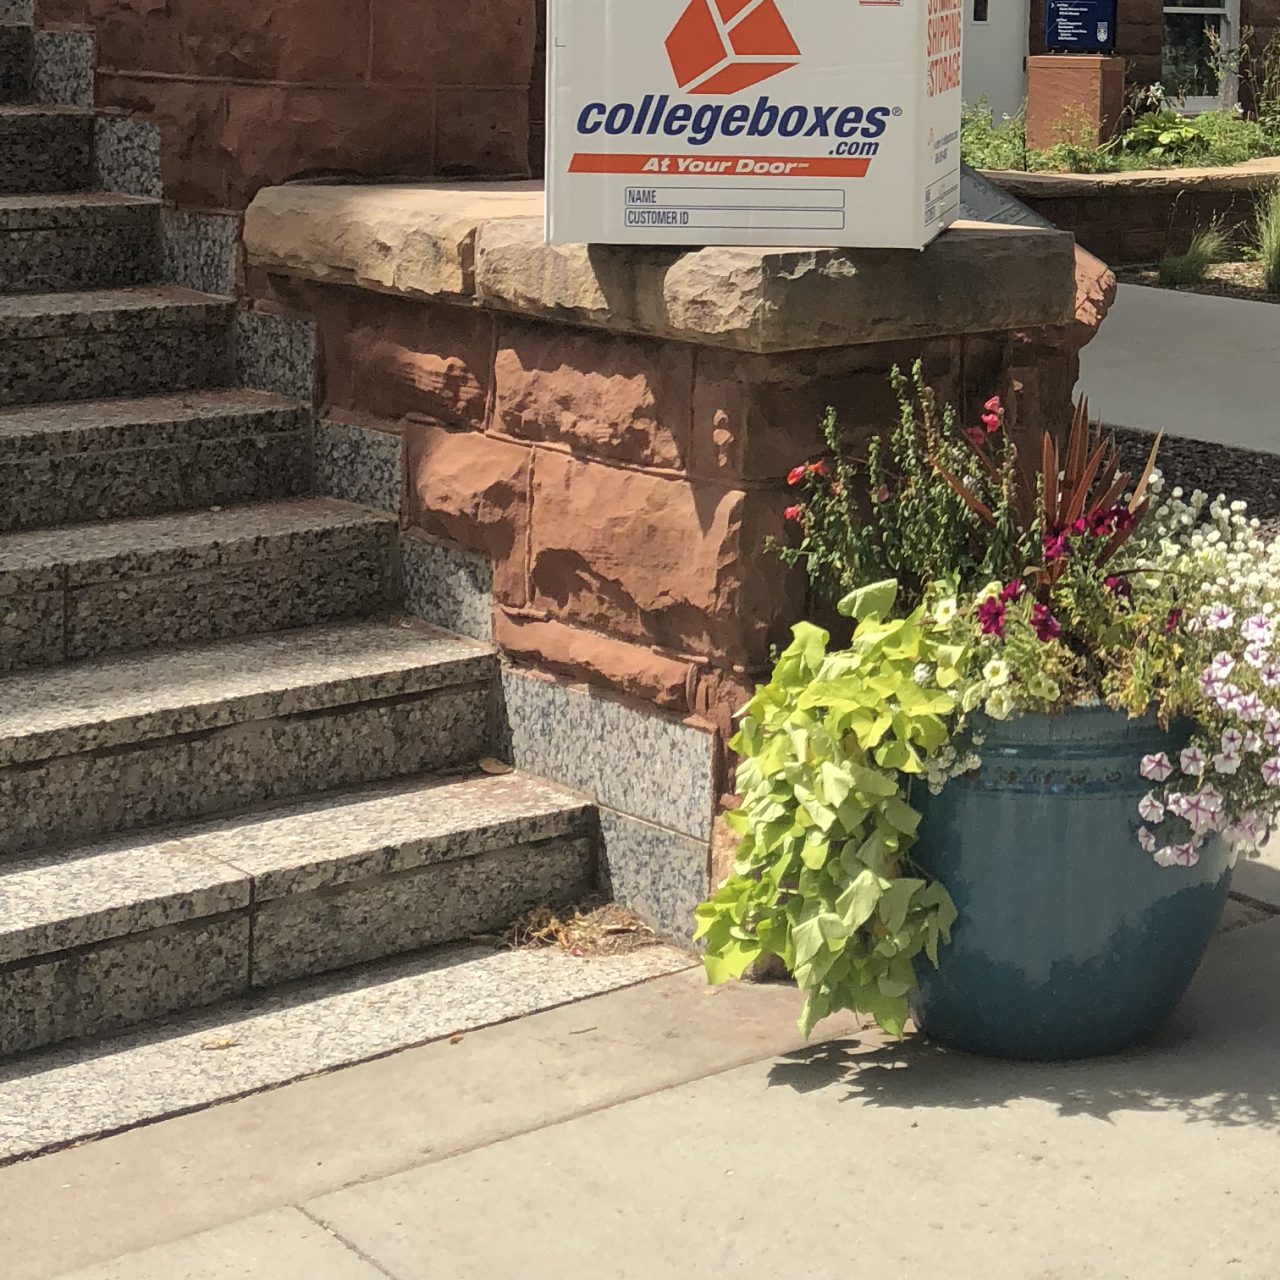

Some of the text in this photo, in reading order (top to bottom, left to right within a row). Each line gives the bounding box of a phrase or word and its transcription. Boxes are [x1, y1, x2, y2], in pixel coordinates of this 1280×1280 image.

[927, 11, 961, 57] SHIPPING
[928, 51, 961, 98] STORAGE
[828, 139, 880, 156] .com
[641, 157, 799, 174] At Your Door
[627, 189, 657, 204] NAME
[627, 209, 689, 225] CUSTOMER ID
